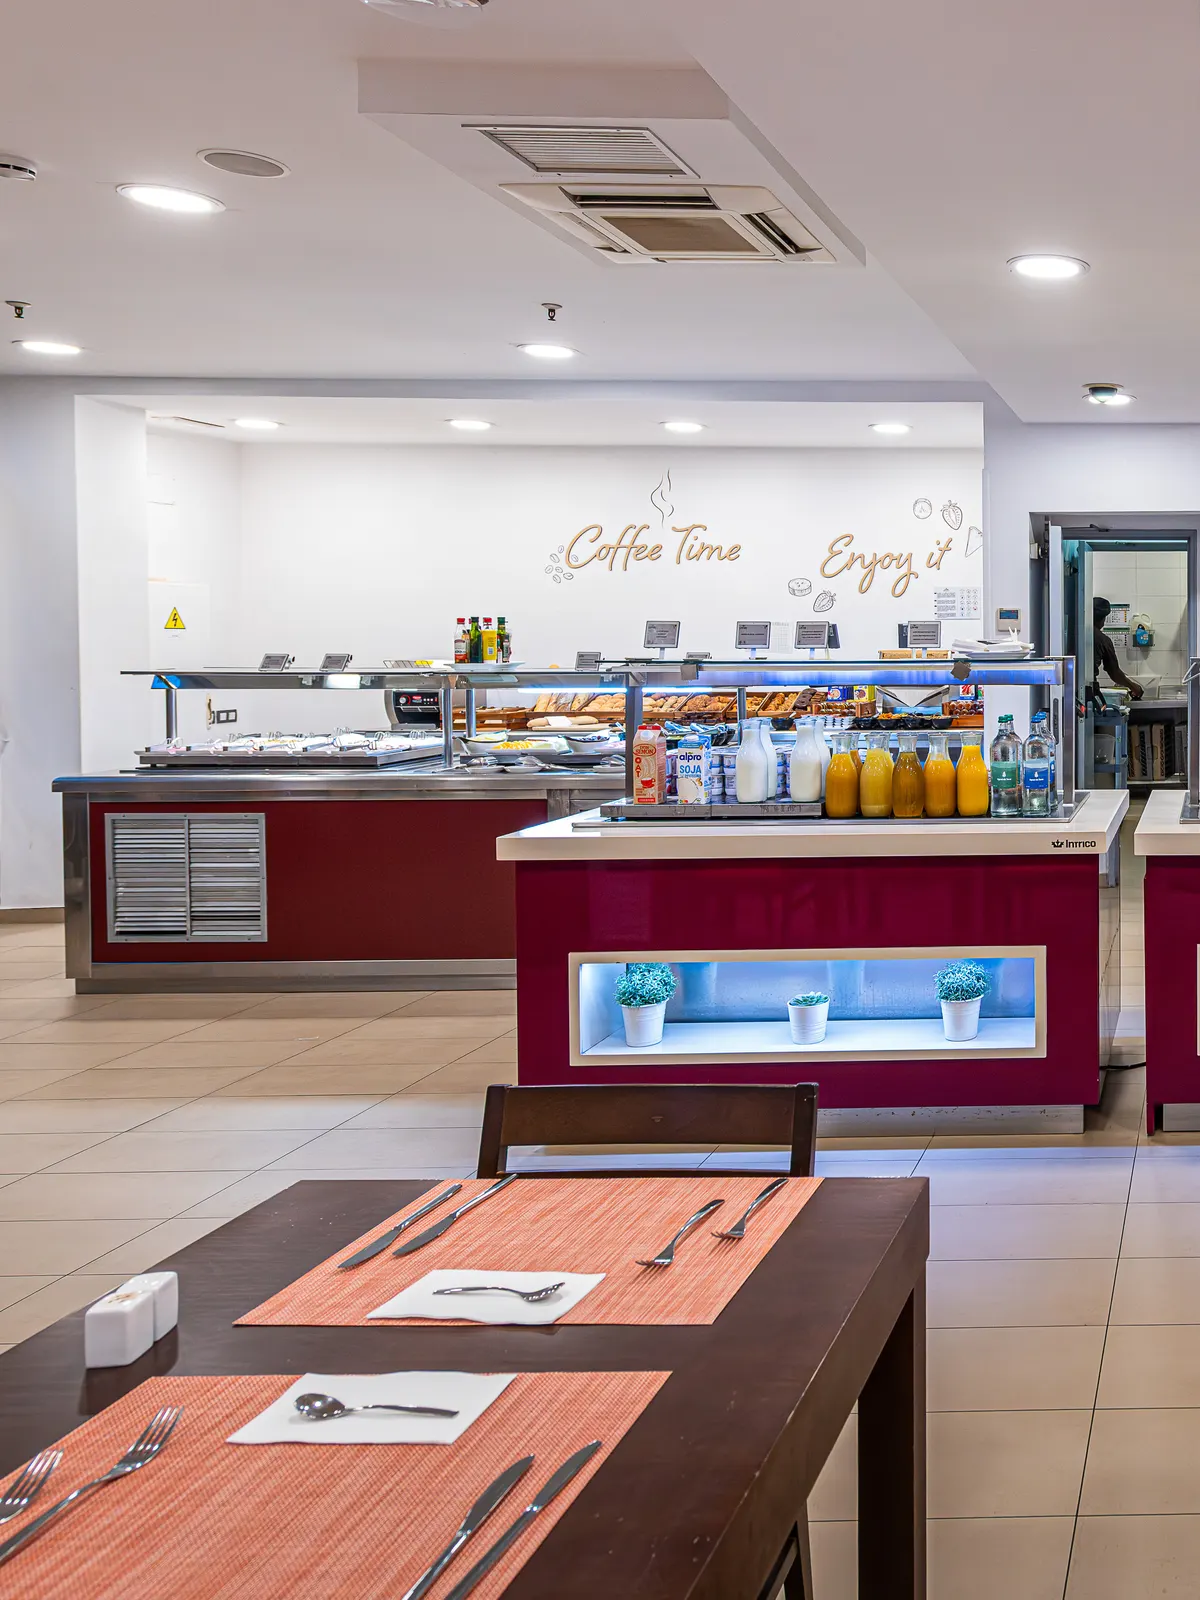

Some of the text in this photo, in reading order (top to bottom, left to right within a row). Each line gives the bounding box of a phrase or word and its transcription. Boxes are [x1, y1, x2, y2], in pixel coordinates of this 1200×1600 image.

[565, 524, 742, 572] Coffee Time
[820, 533, 953, 598] Enjoy it
[634, 756, 642, 778] OAT
[679, 752, 702, 763] alpro
[679, 765, 702, 774] SOJA
